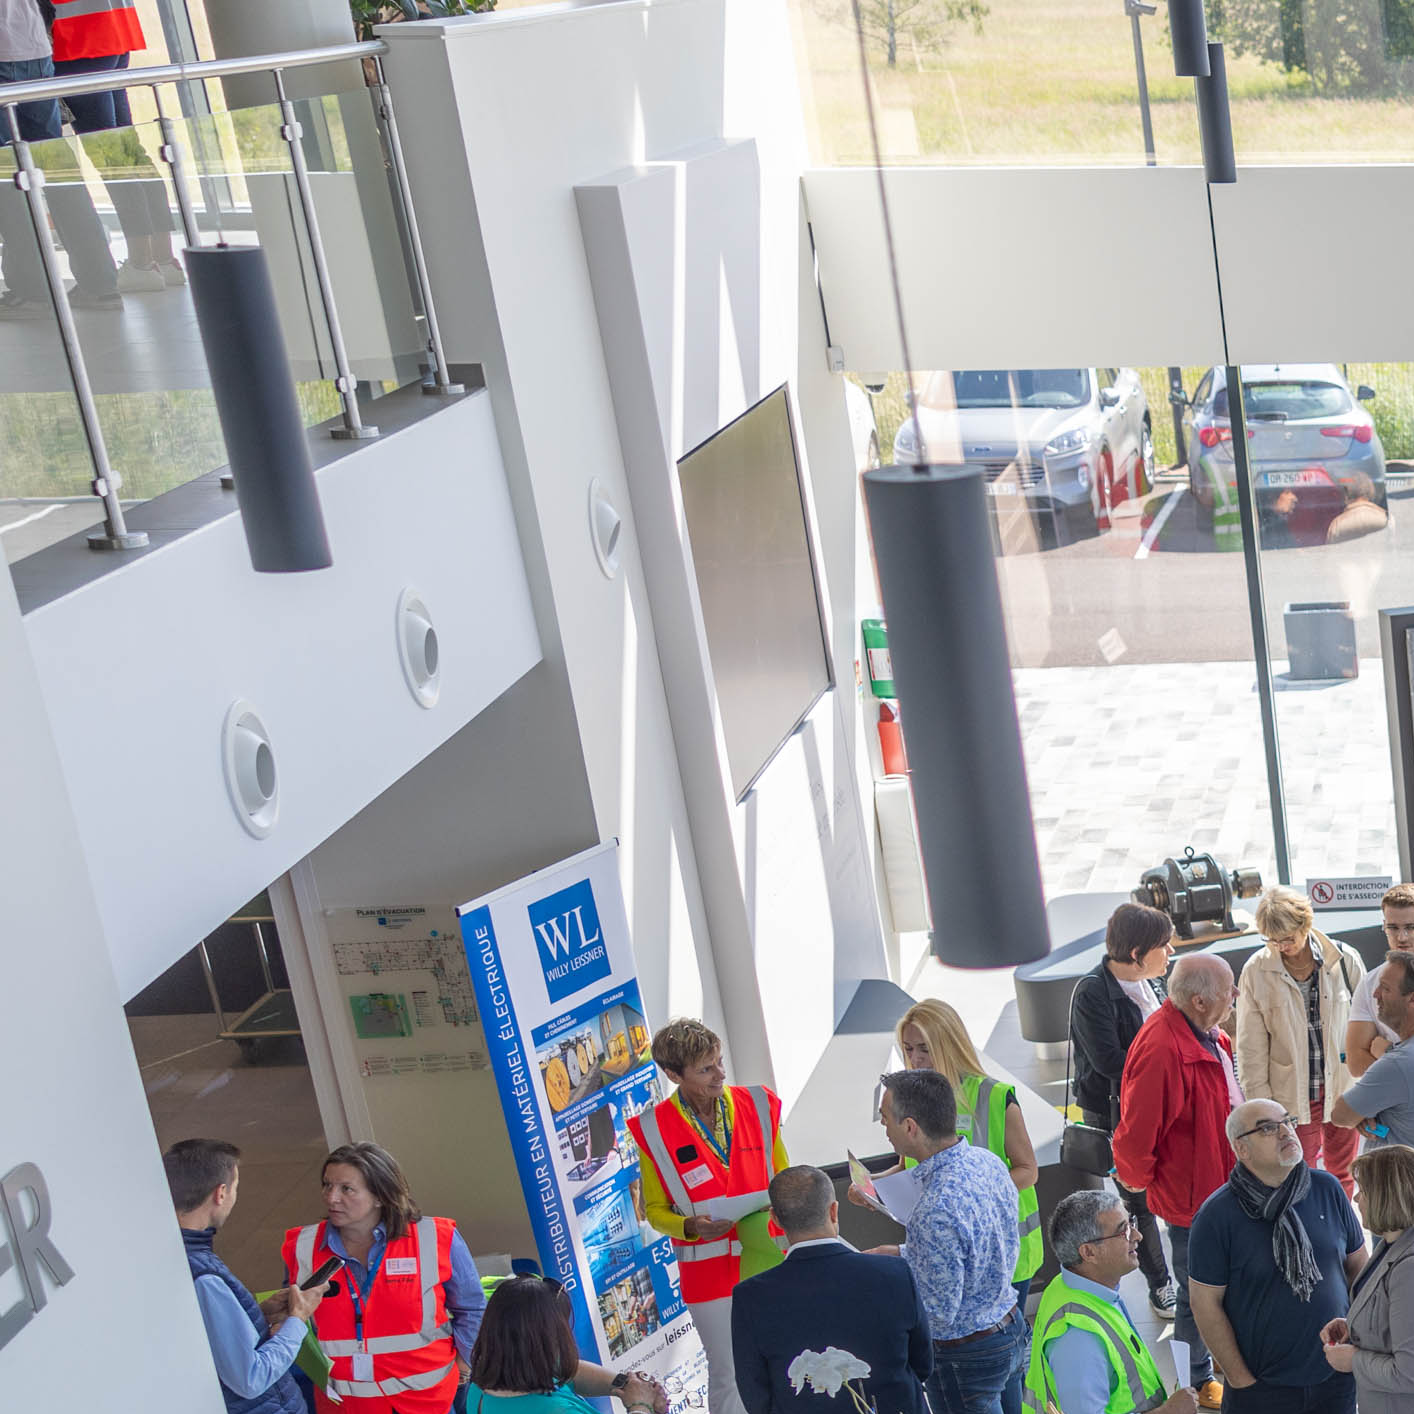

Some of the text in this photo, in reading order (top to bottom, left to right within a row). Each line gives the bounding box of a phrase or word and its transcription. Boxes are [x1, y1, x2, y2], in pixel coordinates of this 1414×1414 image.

[1336, 882, 1389, 890] INTERDICTION
[535, 905, 600, 961] WL
[546, 945, 605, 982] WILLY LEISSNER
[475, 924, 578, 1293] DISTRIBUTEUR EN MATÉRIEL ÉLECTRIQUE
[662, 1301, 681, 1320] WILLY
[656, 1343, 665, 1354] sur
